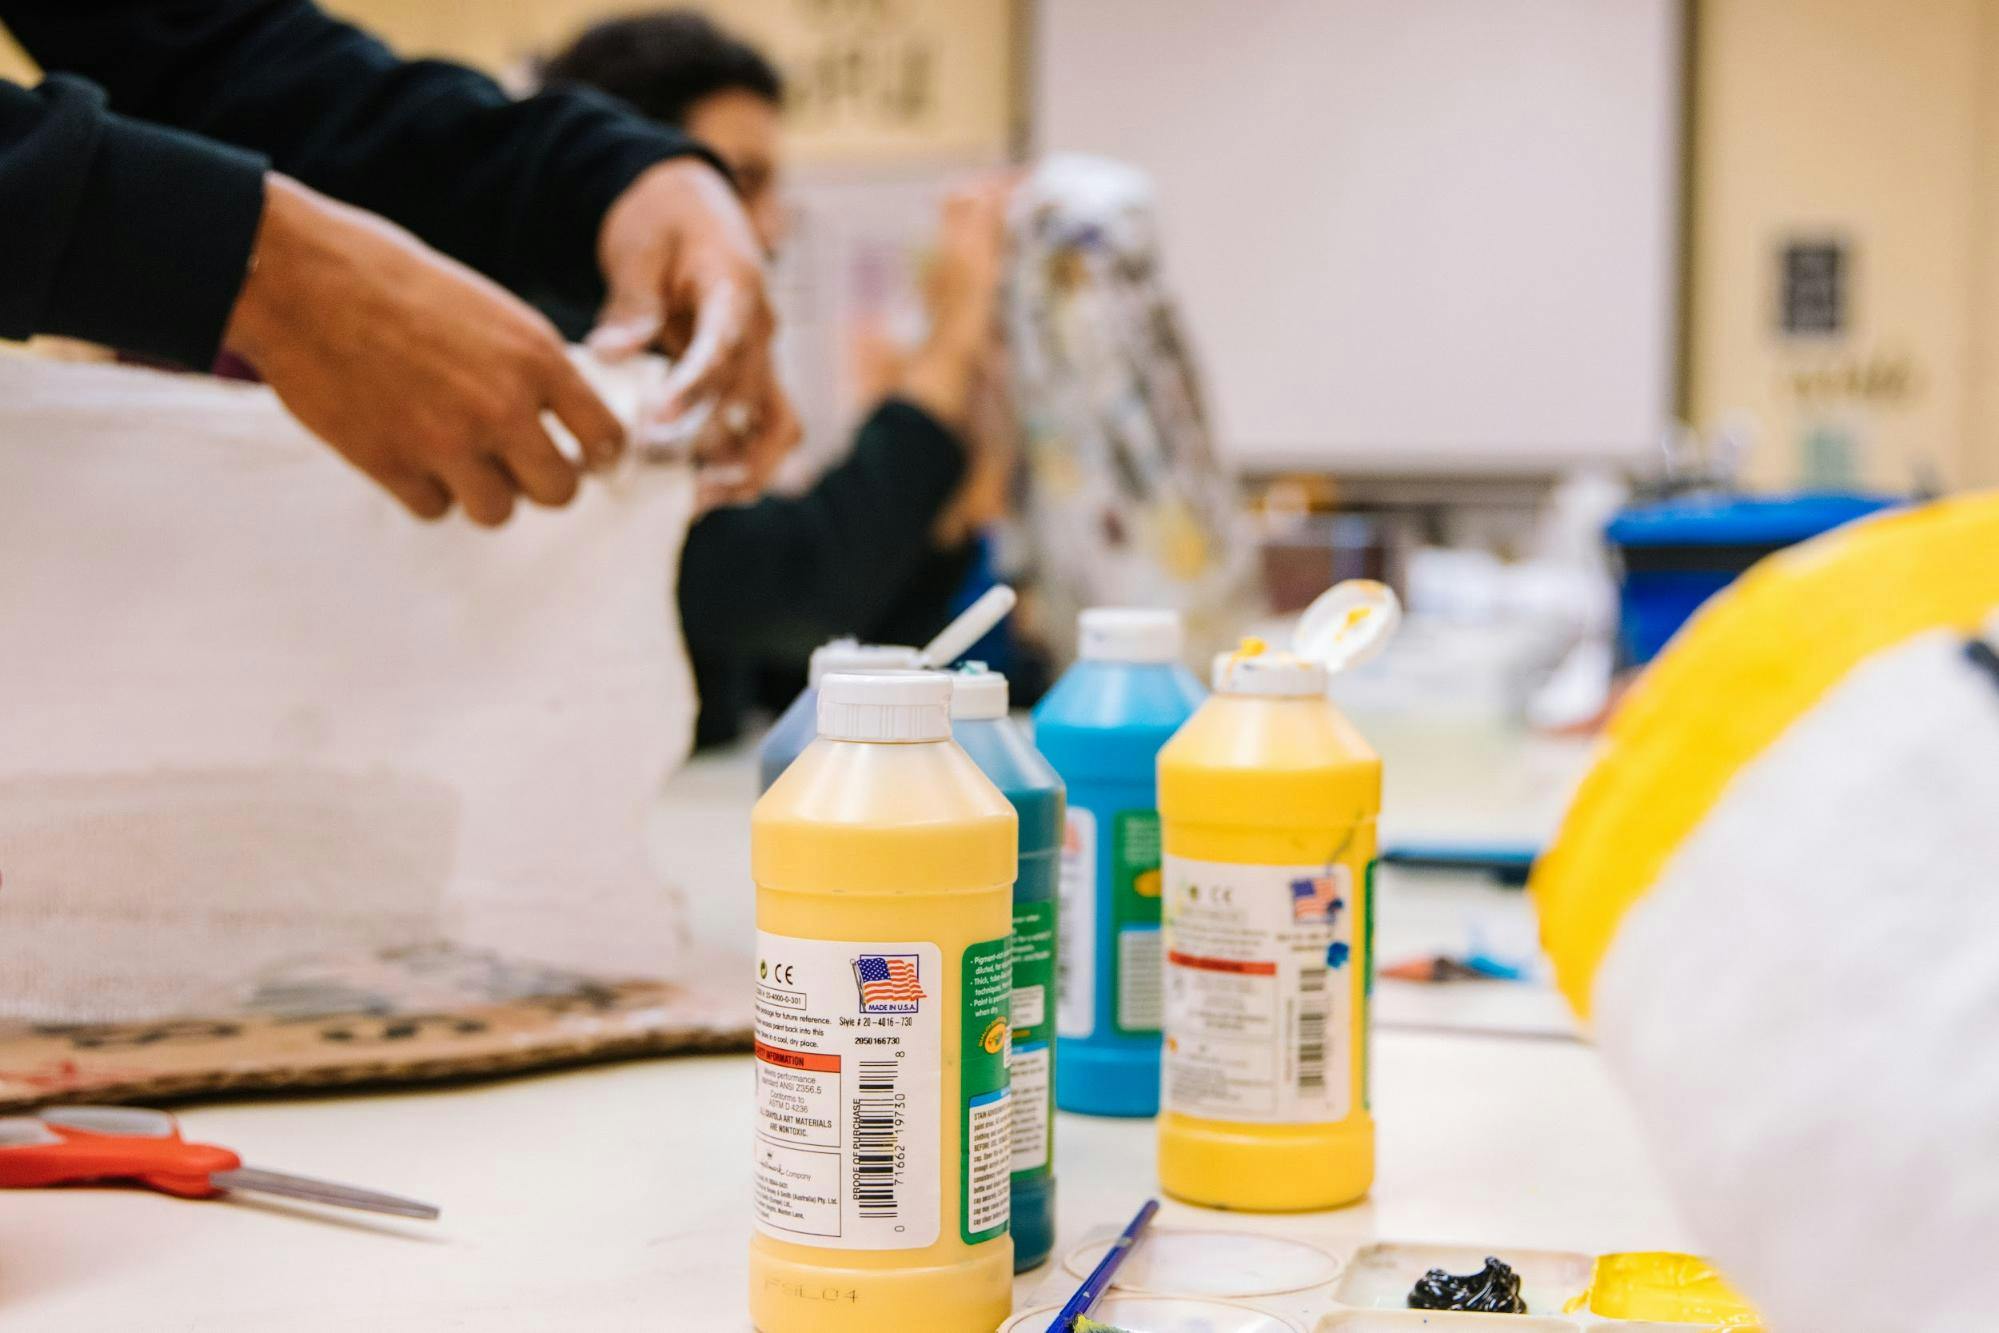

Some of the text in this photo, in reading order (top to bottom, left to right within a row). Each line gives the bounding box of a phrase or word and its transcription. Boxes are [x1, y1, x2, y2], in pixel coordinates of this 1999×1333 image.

[782, 1013, 797, 1022] future
[799, 1014, 832, 1025] reference.
[839, 1017, 855, 1028] Style
[785, 1023, 797, 1032] back
[799, 1026, 811, 1035] into
[812, 1027, 824, 1037] this
[789, 1039, 799, 1047] dry
[854, 1036, 900, 1045] 2050166730
[766, 1050, 805, 1067] INFORMATION
[777, 1071, 816, 1085] performance
[779, 1080, 795, 1091] ANSI
[768, 1097, 784, 1108] ASTM
[785, 1102, 790, 1110] D
[770, 1089, 805, 1104] Conforms to
[894, 1093, 905, 1134] 19730
[783, 1114, 794, 1123] ART
[795, 1117, 832, 1129] MATERIALS
[853, 1099, 861, 1200] PROOF OF PURCHASE
[894, 1145, 905, 1186] 71662
[785, 1169, 812, 1182] Company
